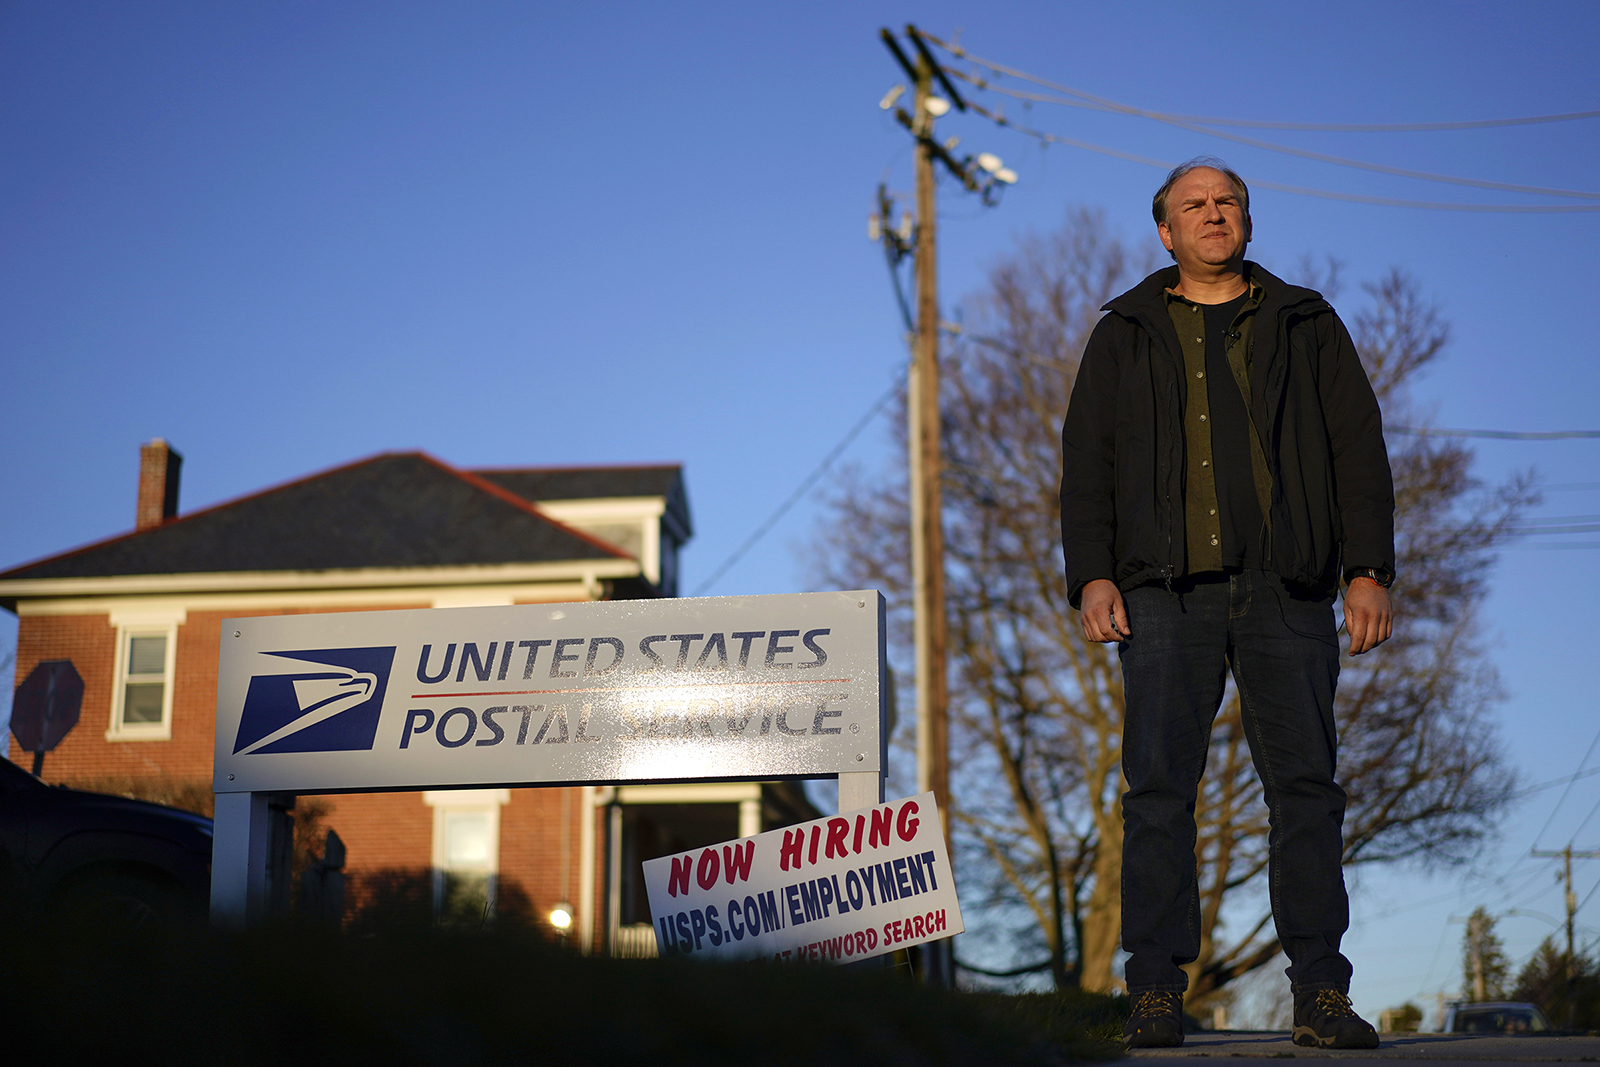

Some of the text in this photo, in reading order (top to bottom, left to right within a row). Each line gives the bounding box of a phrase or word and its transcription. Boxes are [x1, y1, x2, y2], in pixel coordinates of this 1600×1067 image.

[416, 628, 831, 684] UNITED STATES
[14, 686, 79, 724] STOP
[399, 703, 602, 749] POSTAL
[667, 800, 920, 898] NOW HIRING
[659, 850, 939, 954] USPS.COM/EMPLOYMENT
[797, 927, 878, 965] KEYWORD
[883, 908, 947, 947] SEARCH
